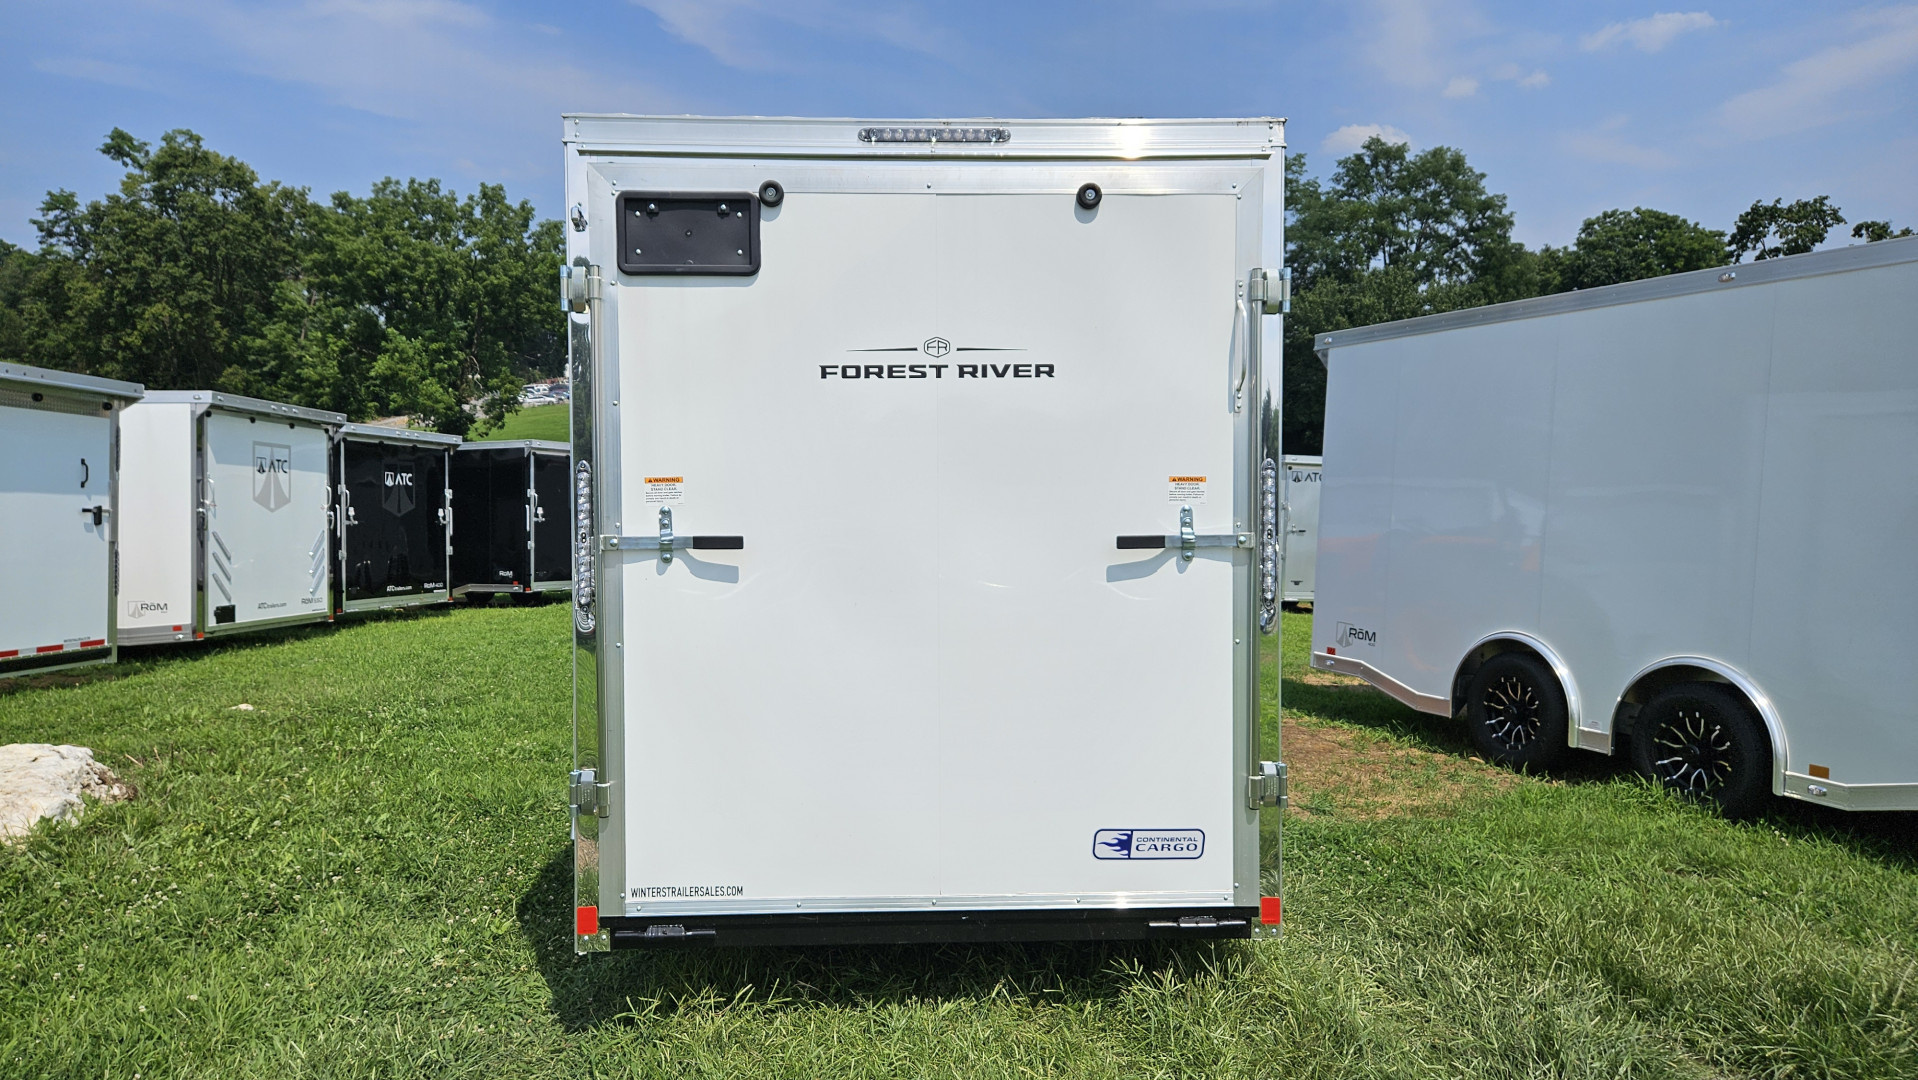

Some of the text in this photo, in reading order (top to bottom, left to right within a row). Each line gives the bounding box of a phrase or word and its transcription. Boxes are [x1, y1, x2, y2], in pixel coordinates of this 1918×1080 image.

[819, 363, 1055, 379] FOREST RIVER
[268, 458, 288, 474] ATC
[394, 472, 413, 486] ATC
[1135, 843, 1198, 852] CARGO
[631, 886, 744, 898] WINTERSTRAILERSALES.COM
